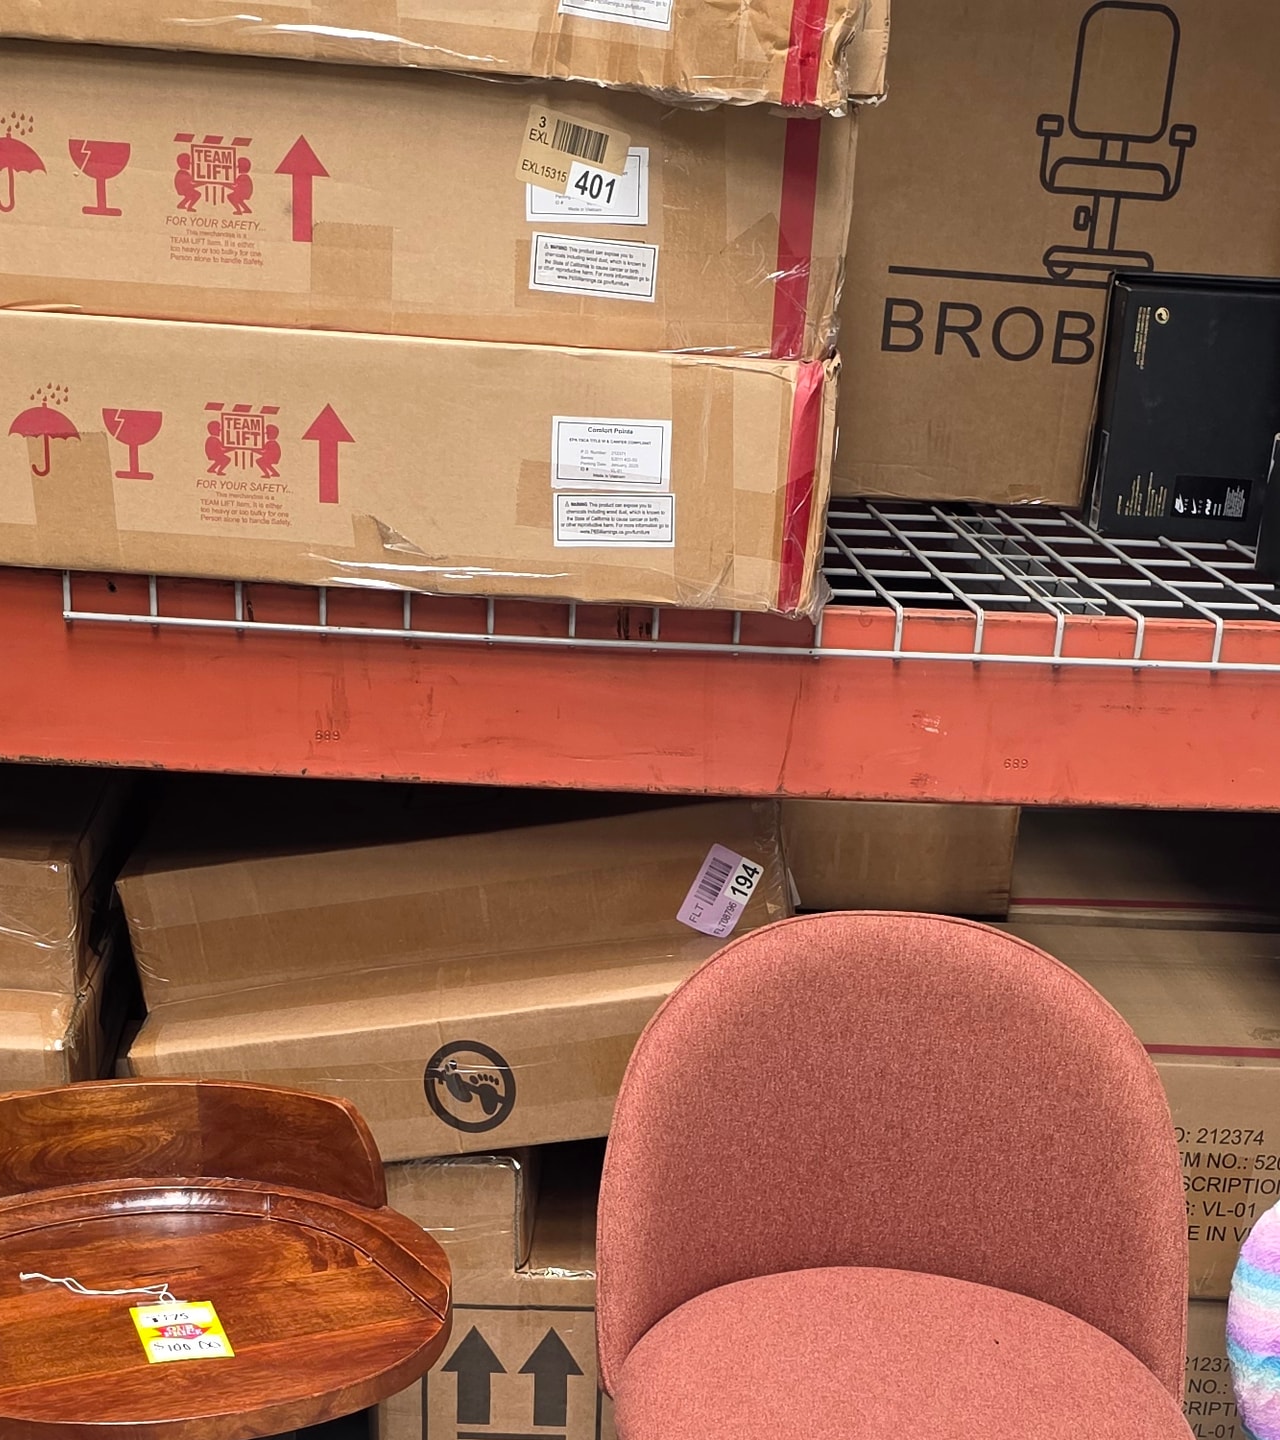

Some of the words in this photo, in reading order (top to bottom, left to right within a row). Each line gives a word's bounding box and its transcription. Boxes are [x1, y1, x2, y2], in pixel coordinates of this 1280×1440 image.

[539, 116, 547, 129] 3
[528, 128, 550, 146] EXL
[194, 148, 232, 164] TEAM
[196, 163, 233, 181] LIFT
[521, 158, 567, 183] EXL15315
[574, 170, 616, 204] 401
[165, 216, 187, 226] FOR
[190, 217, 219, 228] YOUR
[880, 297, 1097, 366] BROB
[225, 417, 260, 431] TEAM
[226, 430, 261, 446] LIFT
[196, 480, 217, 489] FOR
[219, 481, 248, 491] YOUR
[730, 864, 760, 897] 194
[689, 903, 704, 923] FLT
[1197, 1128, 1265, 1146] 212374
[1207, 1153, 1248, 1170] NO.:
[1203, 1201, 1255, 1218] VL-01
[1188, 1379, 1227, 1394] NO.:
